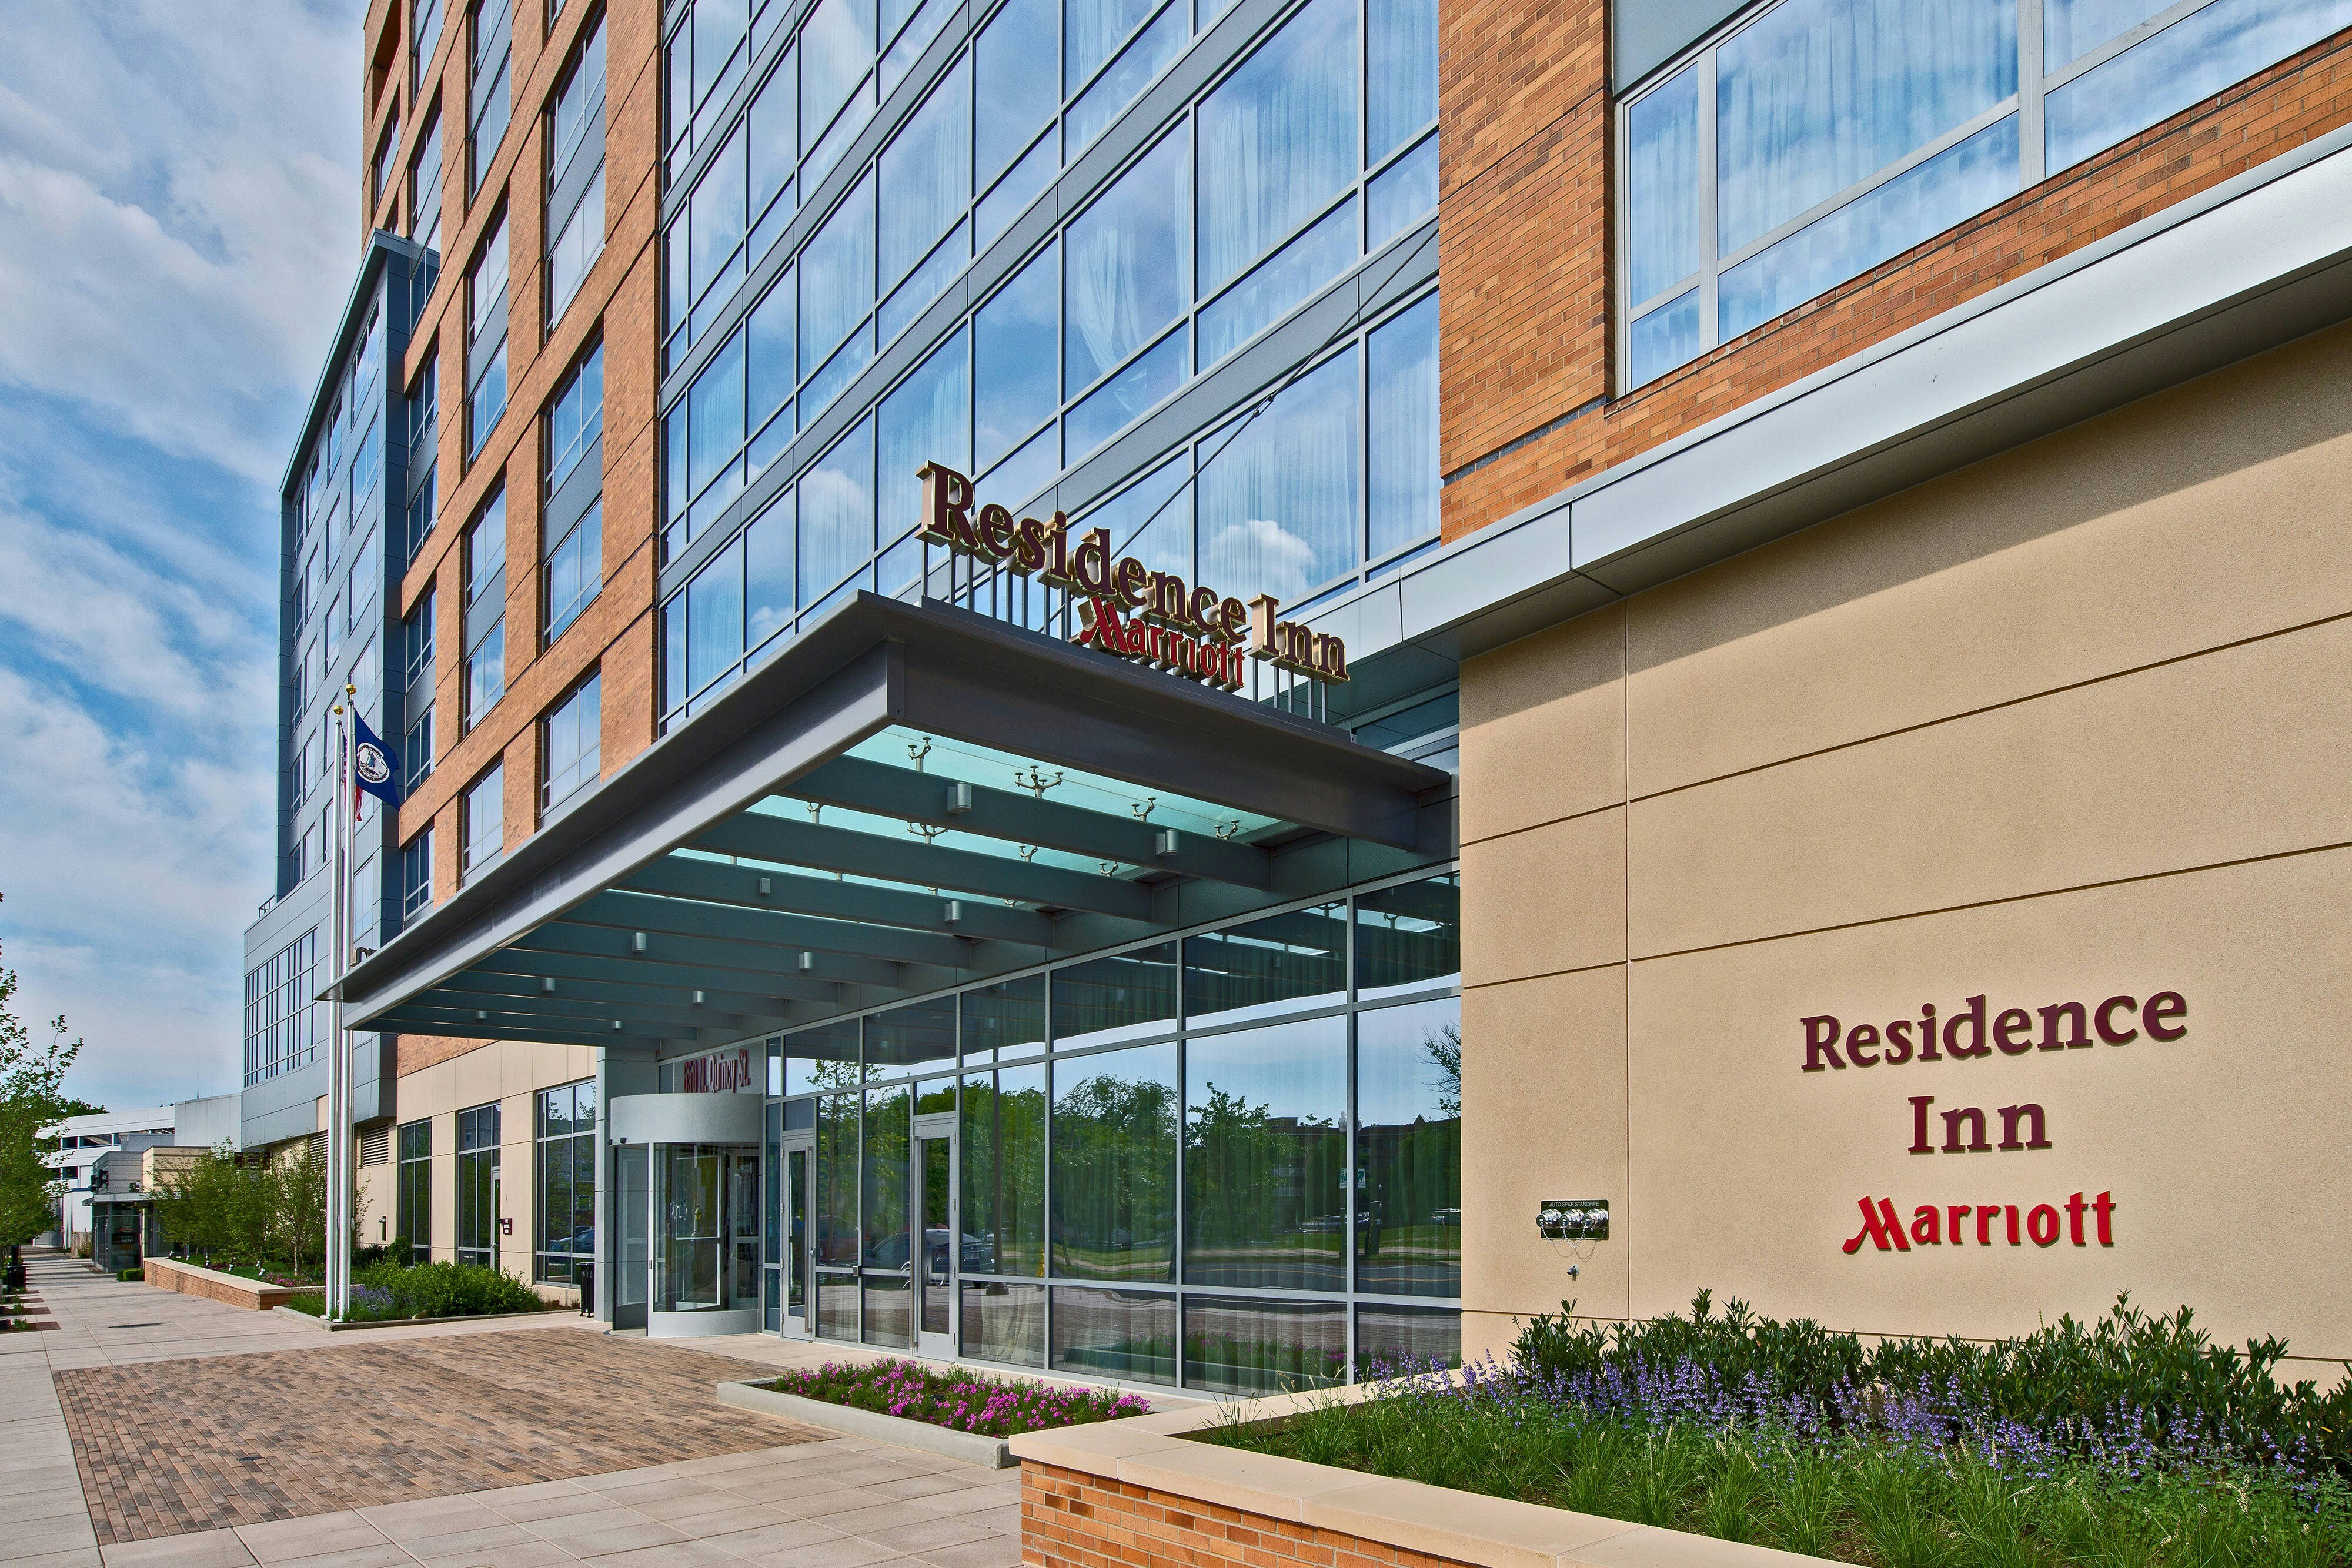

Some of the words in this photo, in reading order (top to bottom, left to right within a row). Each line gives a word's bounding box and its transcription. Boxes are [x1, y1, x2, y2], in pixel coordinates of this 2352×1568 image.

[915, 460, 1247, 644] Residence
[1247, 593, 1351, 686] Inn
[1069, 596, 1246, 693] Marriott
[1800, 991, 2187, 1072] Residence
[700, 1058, 707, 1093] N.
[709, 1054, 738, 1093] Quincy
[739, 1049, 750, 1087] St.
[1907, 1095, 2052, 1154] Inn
[1842, 1191, 2116, 1253] Marriott
